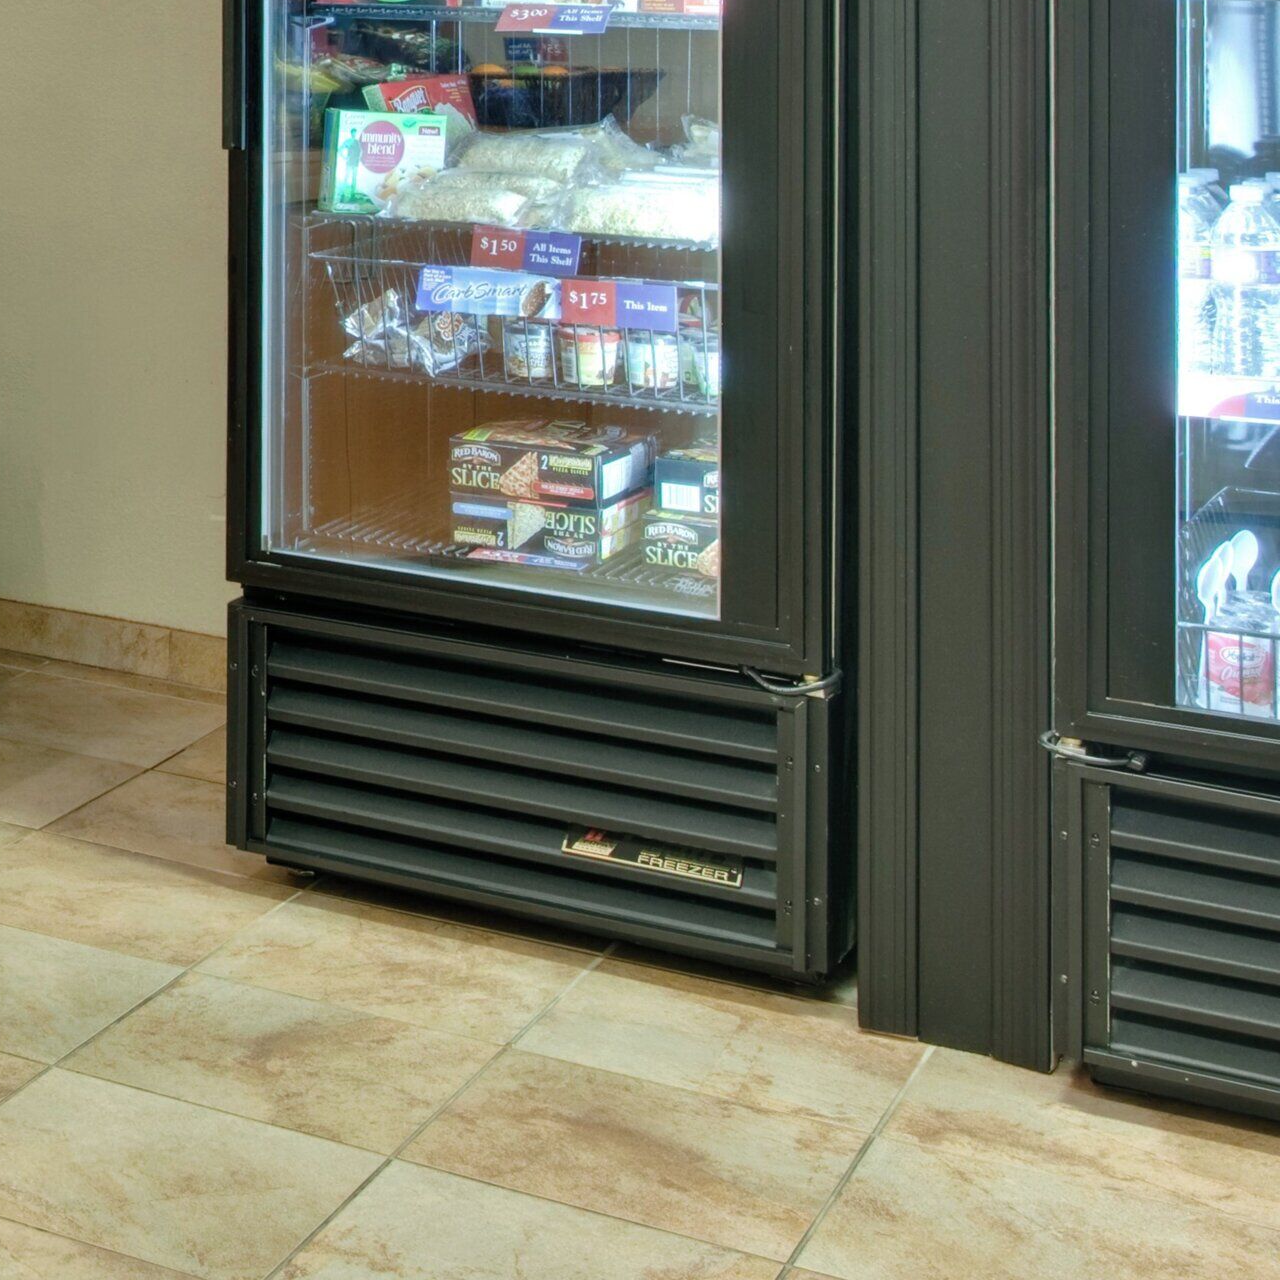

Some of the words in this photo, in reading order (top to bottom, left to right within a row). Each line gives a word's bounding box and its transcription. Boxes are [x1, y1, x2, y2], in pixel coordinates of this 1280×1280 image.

[360, 131, 403, 147] immunity
[367, 142, 396, 156] blend
[451, 467, 501, 490] SLICE
[644, 547, 699, 569] SLICE
[637, 854, 730, 882] FREEZER
